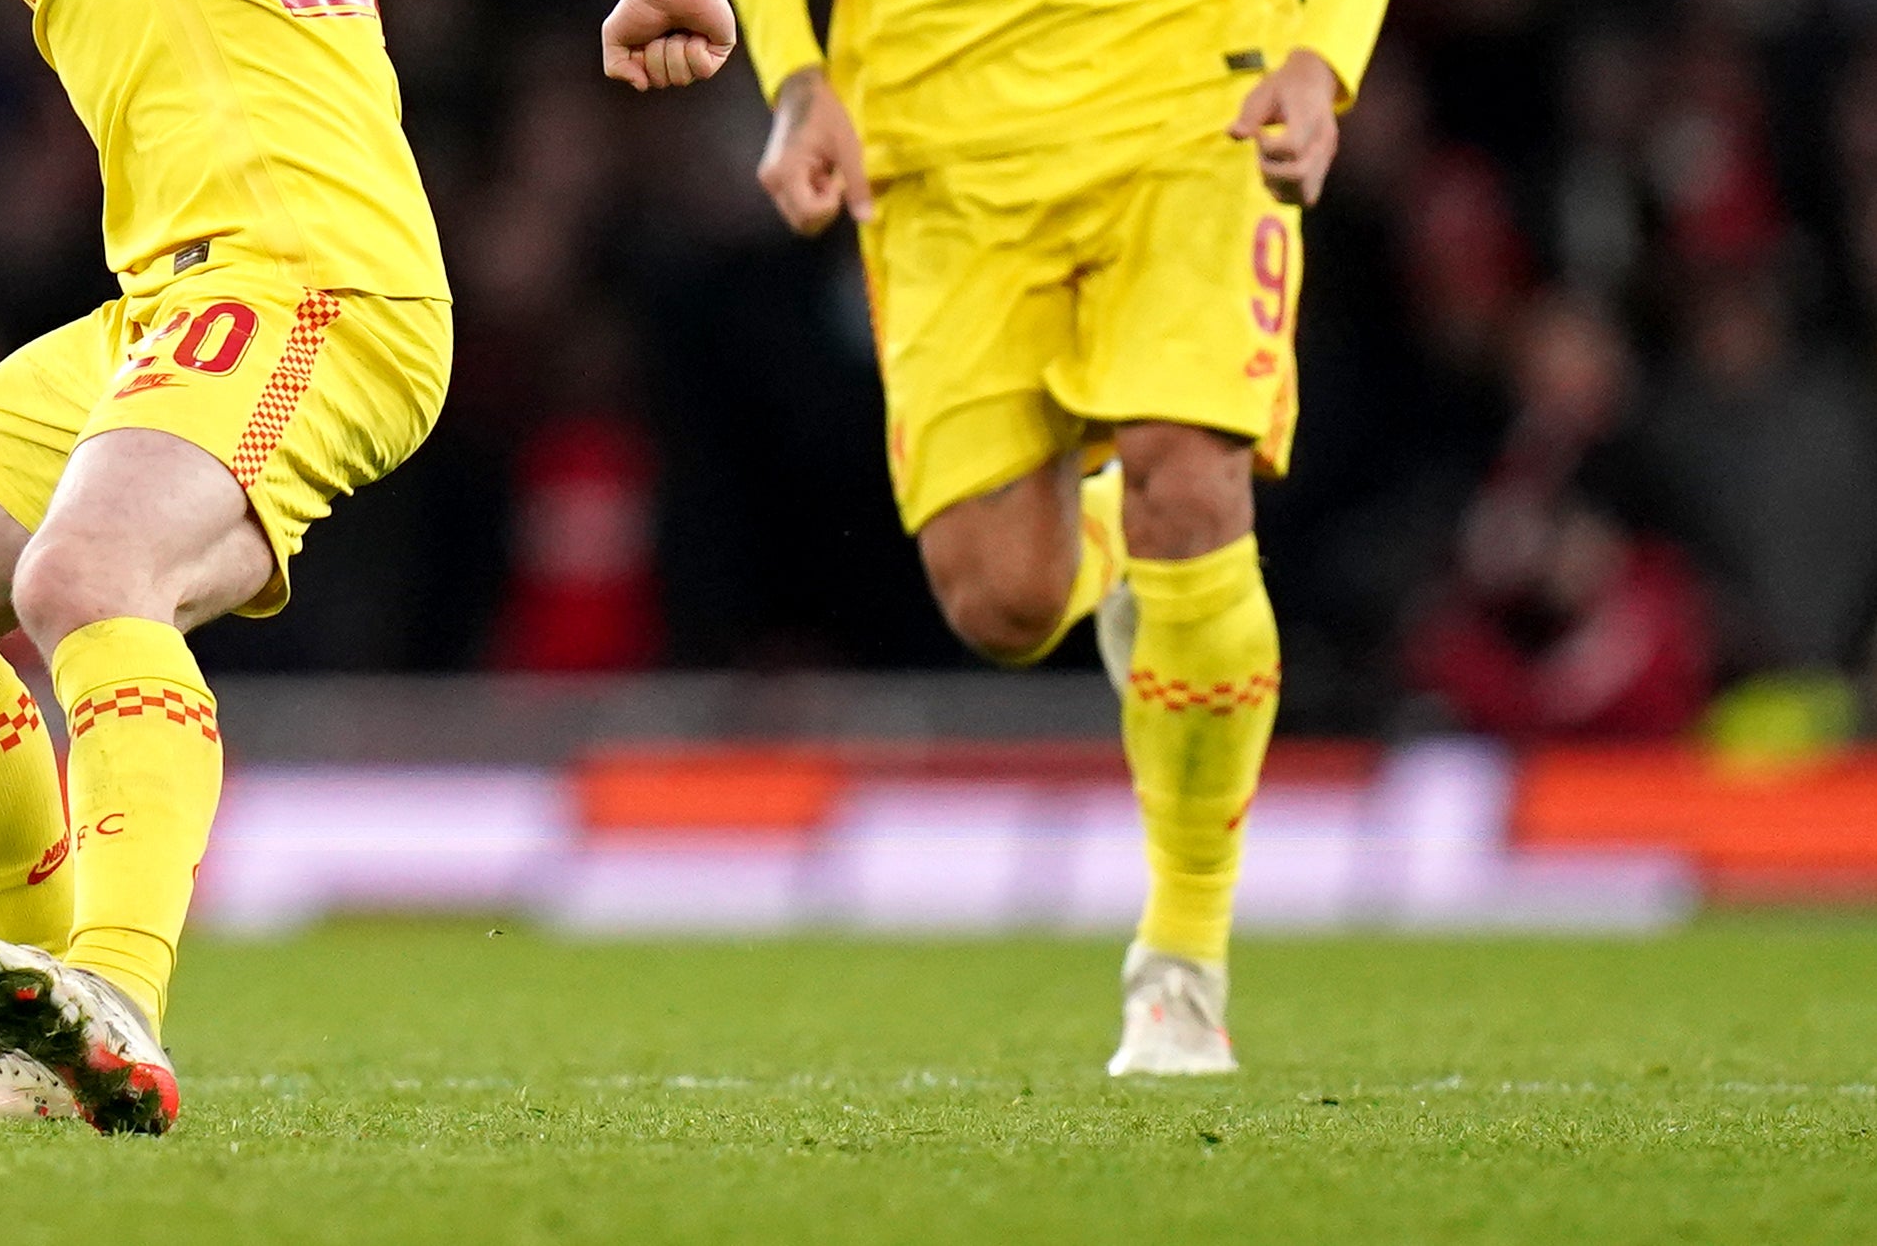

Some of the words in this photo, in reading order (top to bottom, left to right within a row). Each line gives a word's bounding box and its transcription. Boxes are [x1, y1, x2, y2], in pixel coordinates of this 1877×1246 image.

[1252, 215, 1288, 334] 9
[114, 301, 260, 377] 20
[127, 372, 177, 390] NIKE
